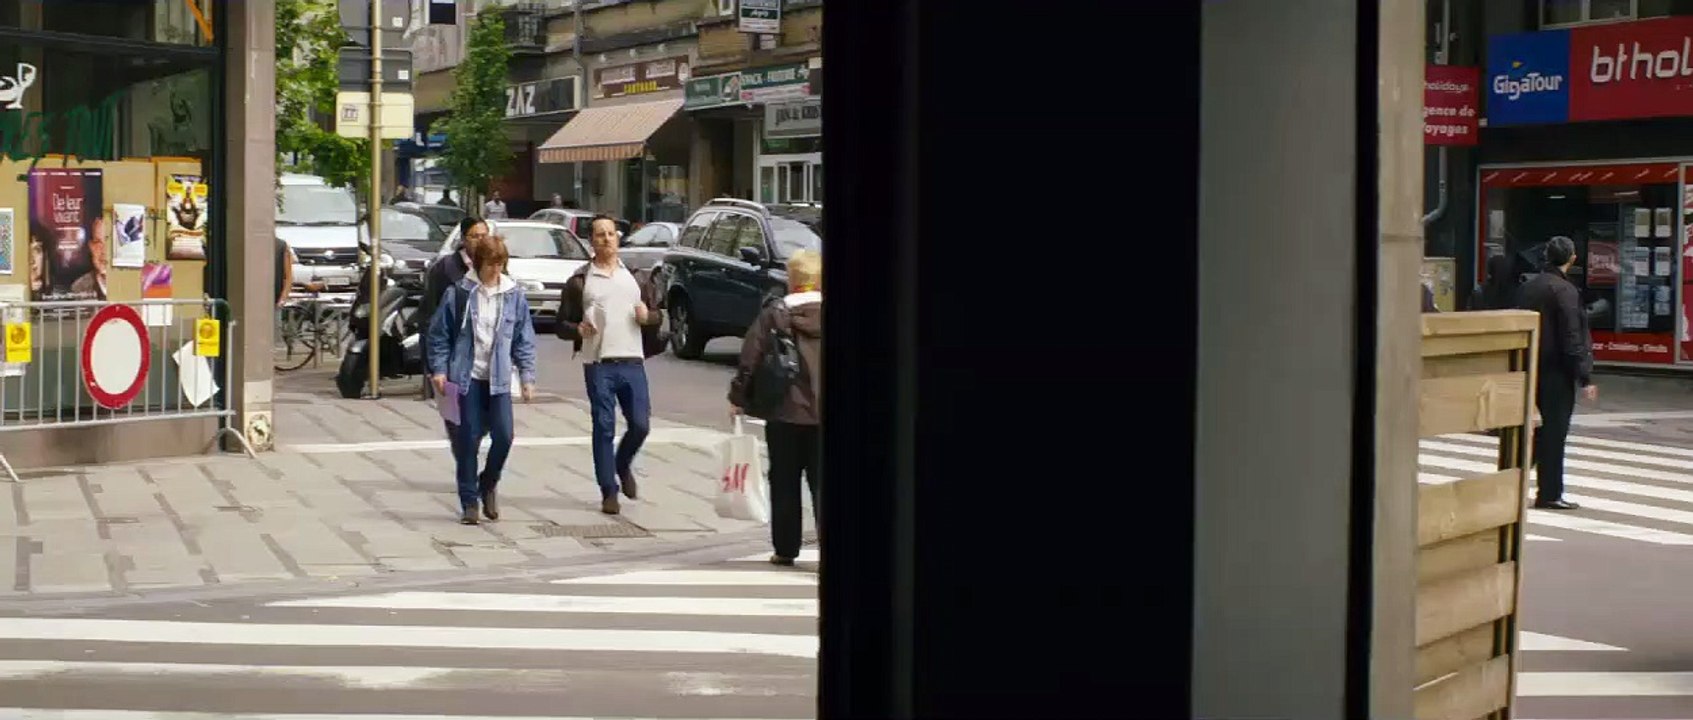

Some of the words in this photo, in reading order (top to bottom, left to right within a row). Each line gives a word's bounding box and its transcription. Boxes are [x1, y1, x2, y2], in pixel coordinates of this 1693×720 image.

[1493, 72, 1563, 101] GigaTour
[505, 85, 536, 116] ZAZ
[1424, 106, 1456, 118] gence
[1424, 122, 1469, 137] oyages
